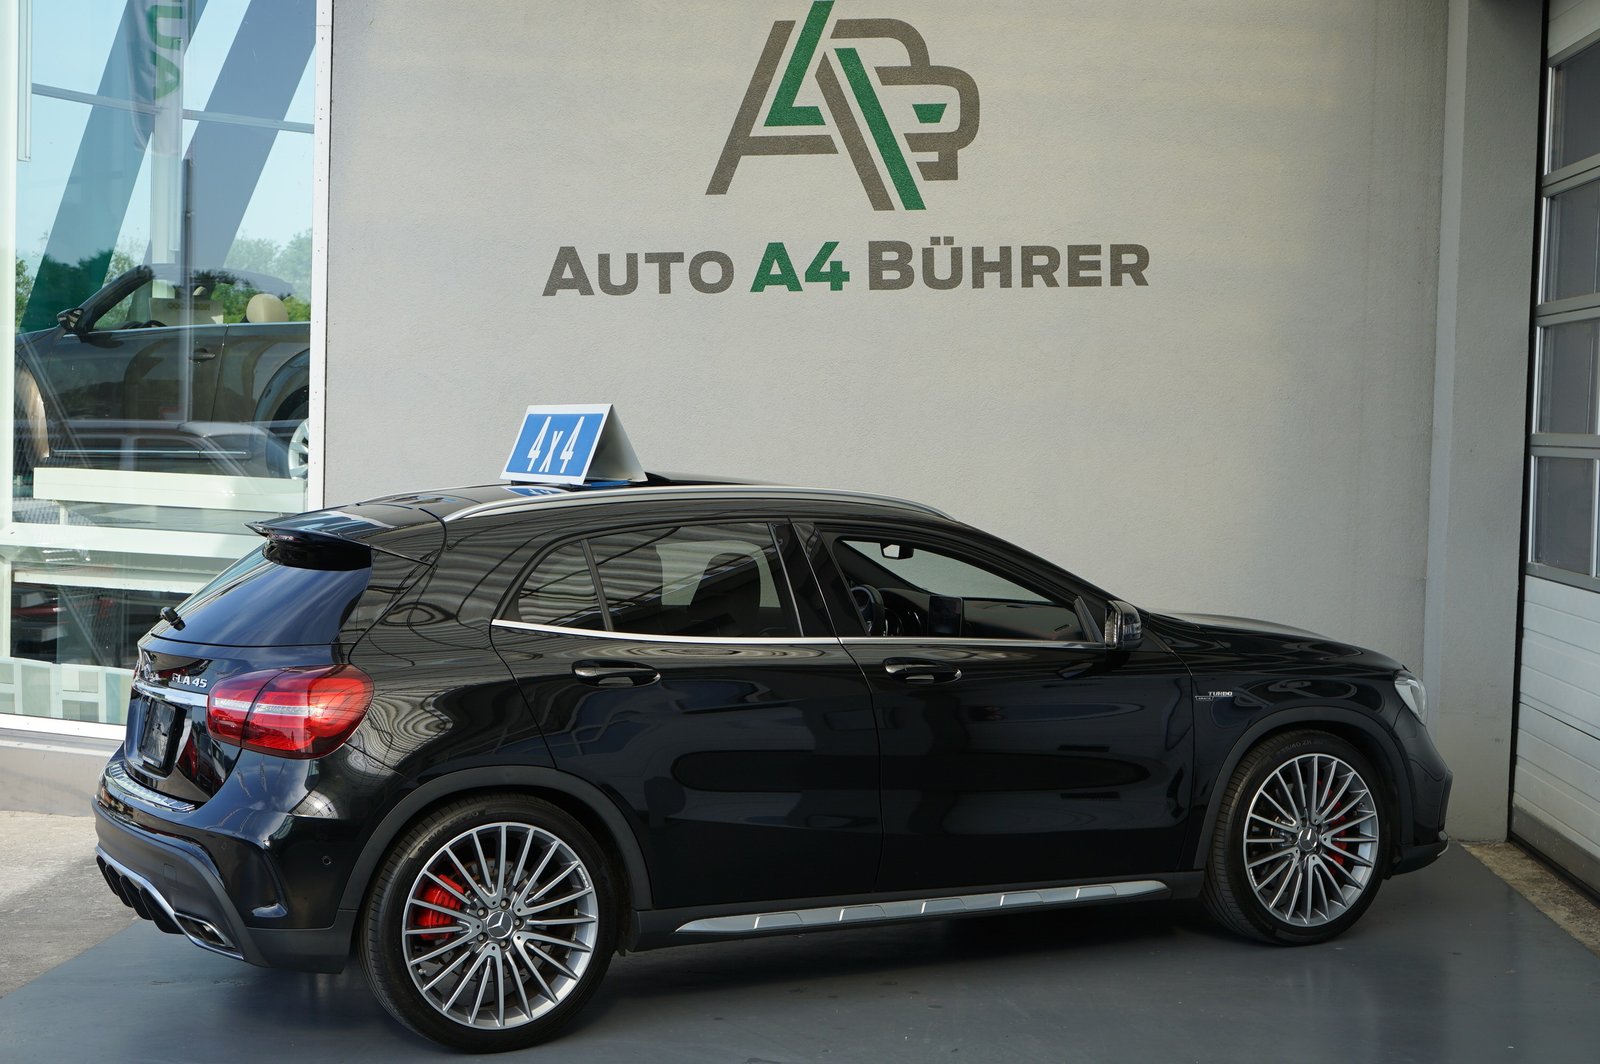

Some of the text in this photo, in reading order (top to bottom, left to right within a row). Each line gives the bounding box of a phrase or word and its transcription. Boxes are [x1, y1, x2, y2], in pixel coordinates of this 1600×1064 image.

[543, 236, 1150, 296] AUTO A4 BÜHRER
[192, 678, 208, 688] 45
